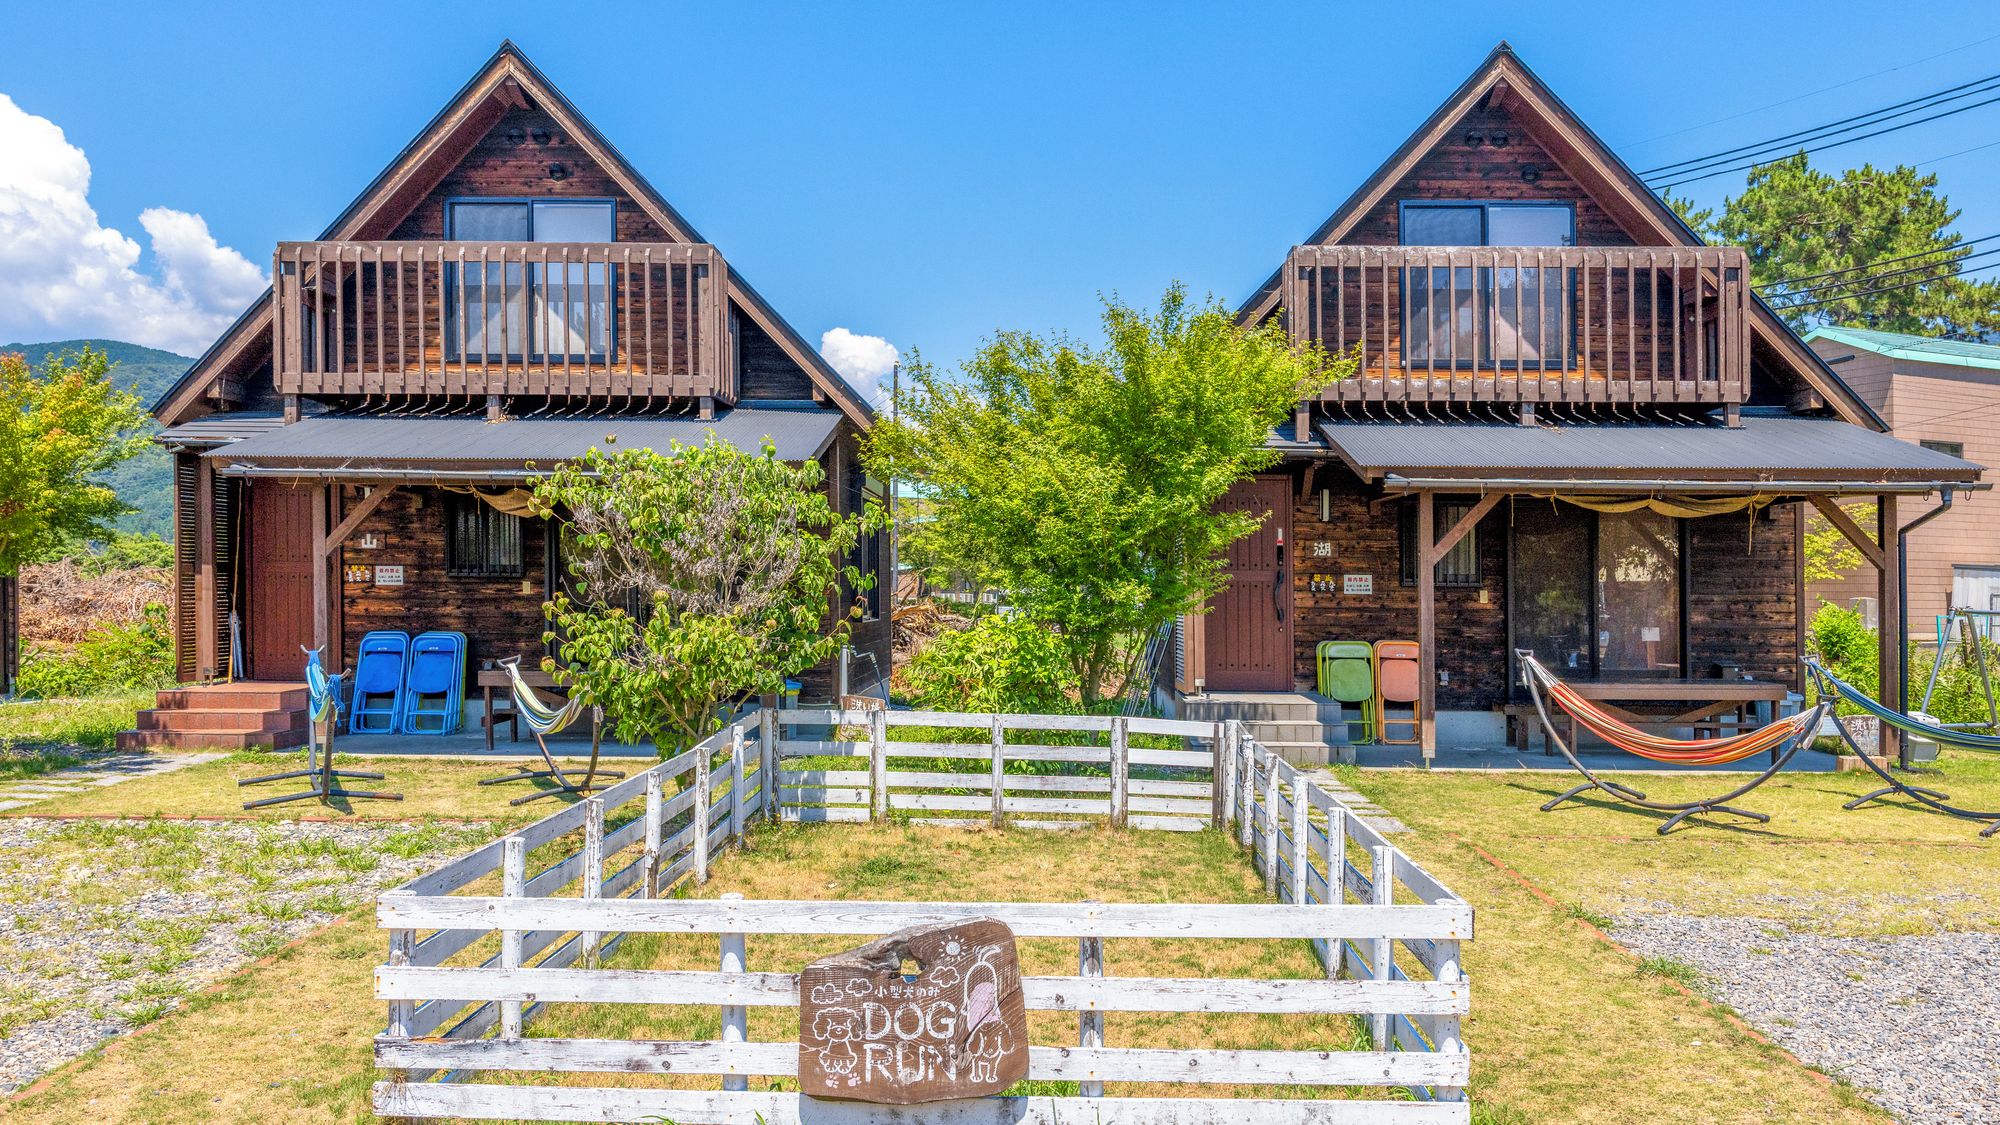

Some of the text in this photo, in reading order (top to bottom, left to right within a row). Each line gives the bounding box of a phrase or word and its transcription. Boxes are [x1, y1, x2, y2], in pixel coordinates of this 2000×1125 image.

[361, 533, 377, 549] 山
[1313, 542, 1331, 557] 湖
[874, 985, 941, 999] 小型犬のみ
[862, 1001, 957, 1040] DOG
[863, 1043, 957, 1084] RUN
